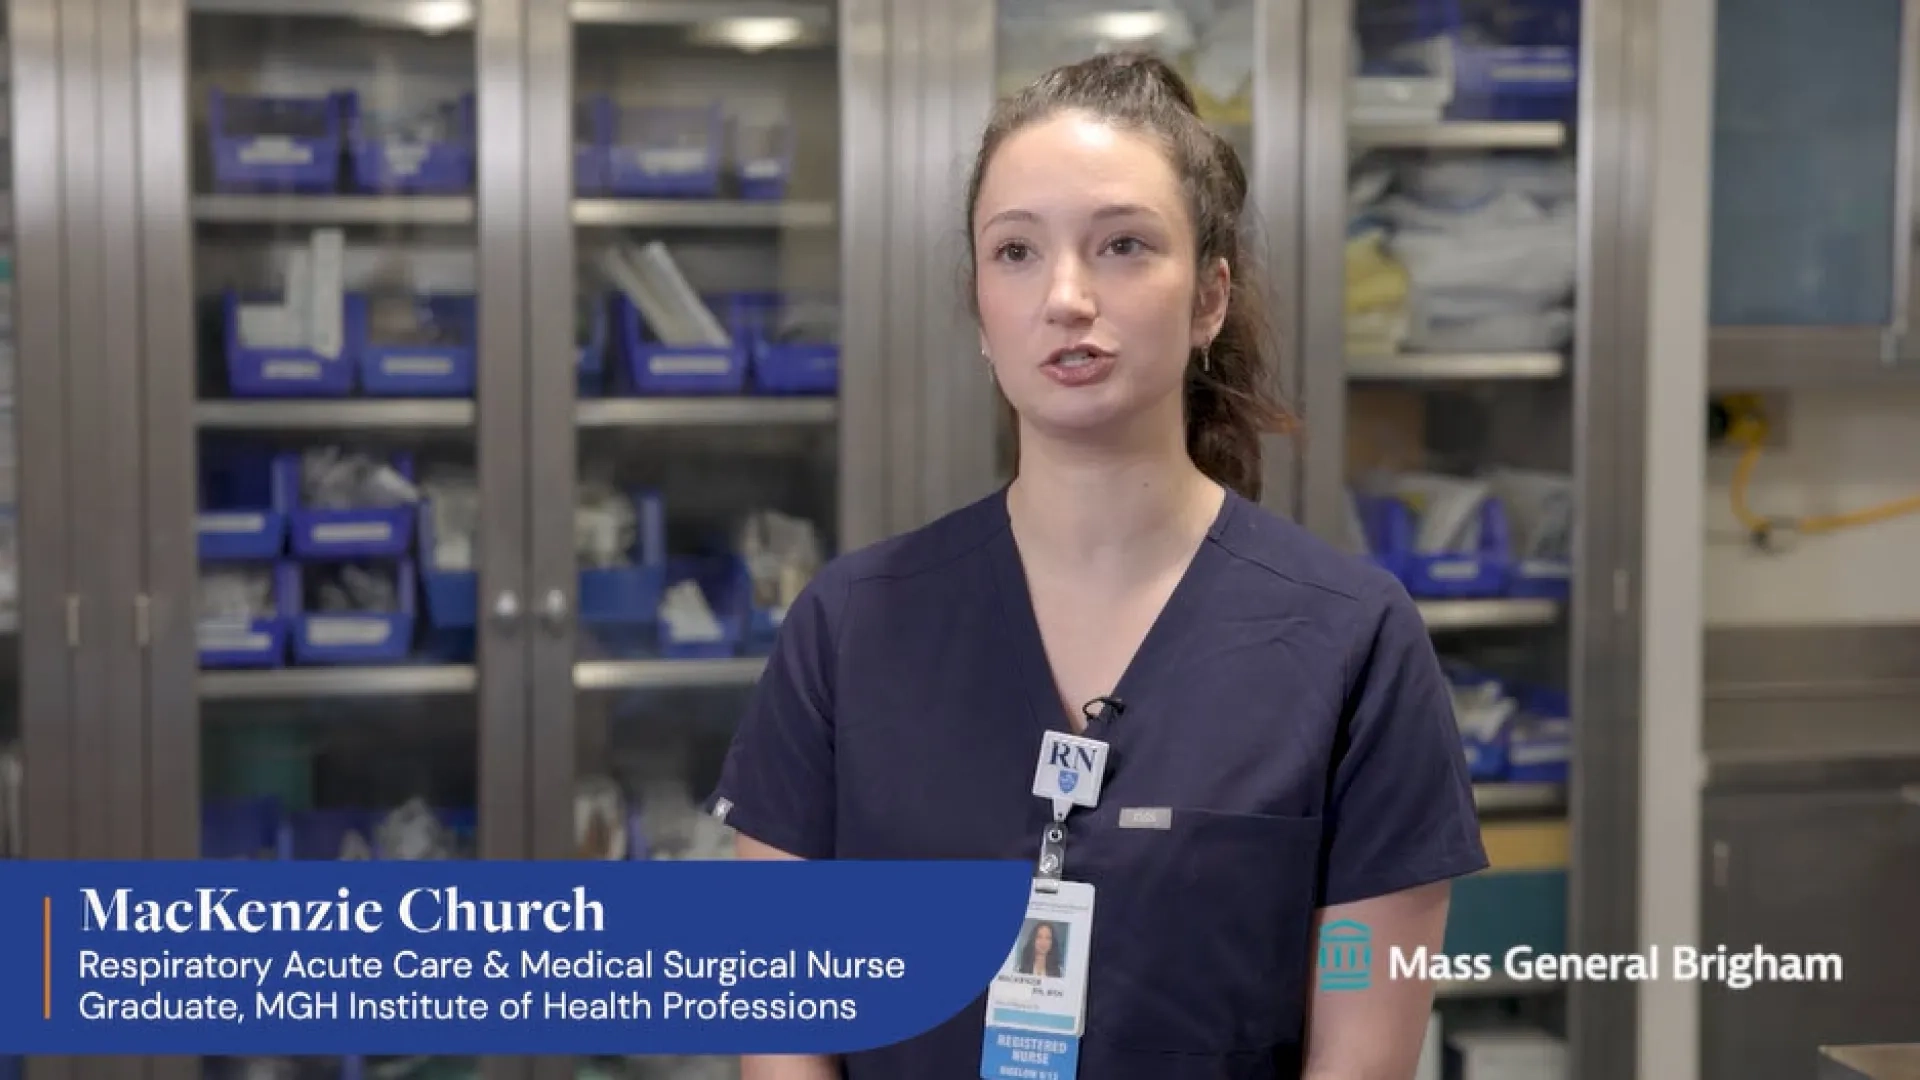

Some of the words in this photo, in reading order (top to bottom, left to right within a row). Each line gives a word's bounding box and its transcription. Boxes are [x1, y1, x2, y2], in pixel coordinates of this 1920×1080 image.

[1049, 740, 1098, 773] RN
[997, 1033, 1067, 1054] REGISTERED
[1012, 1048, 1049, 1064] NURSE
